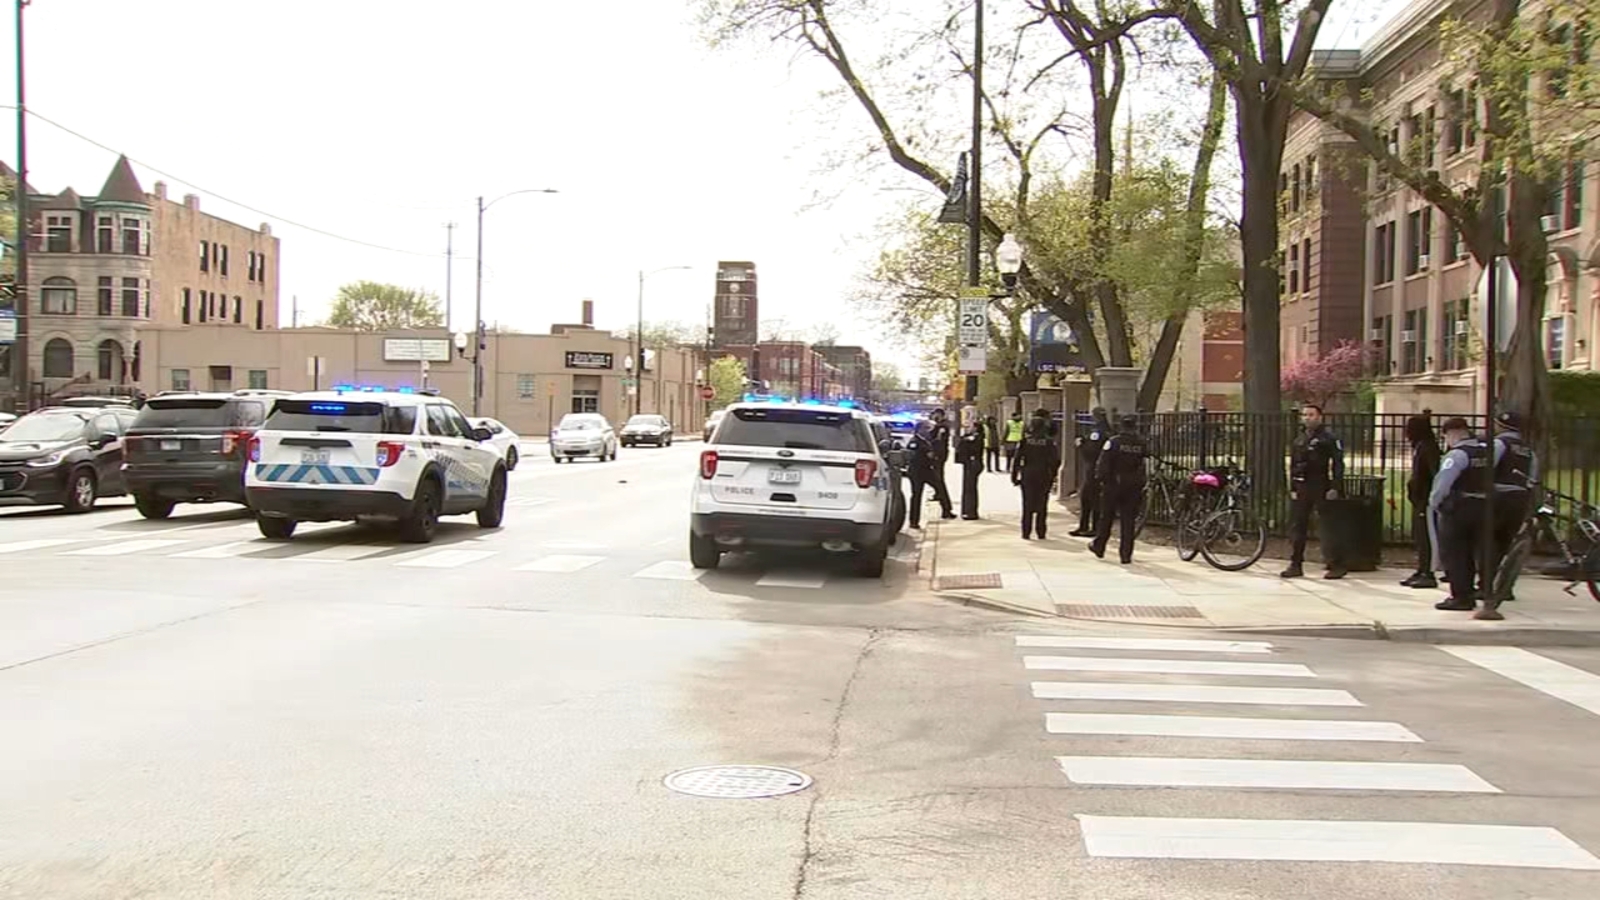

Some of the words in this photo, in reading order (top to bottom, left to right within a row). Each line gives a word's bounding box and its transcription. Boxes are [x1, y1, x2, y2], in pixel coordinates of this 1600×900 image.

[962, 314, 984, 327] 20
[1026, 438, 1046, 446] POLICE
[1119, 444, 1142, 453] POLICE
[724, 486, 755, 495] POLICE
